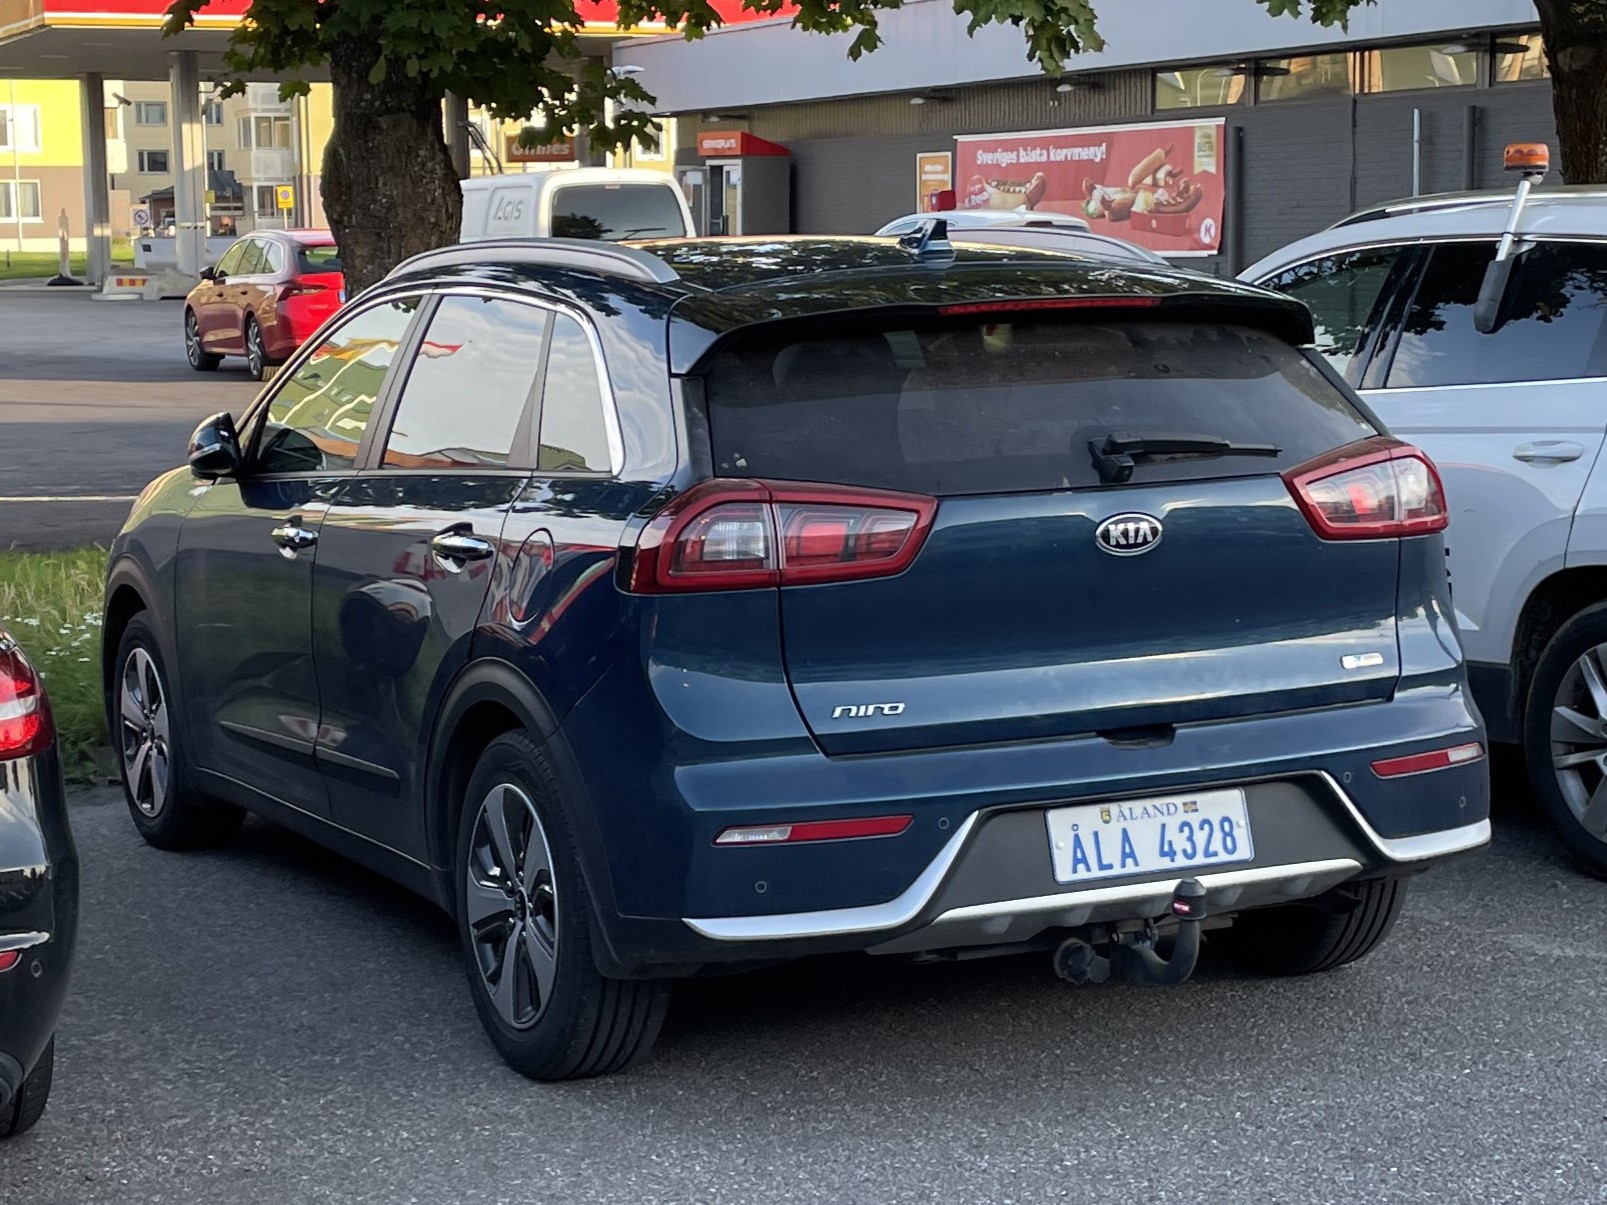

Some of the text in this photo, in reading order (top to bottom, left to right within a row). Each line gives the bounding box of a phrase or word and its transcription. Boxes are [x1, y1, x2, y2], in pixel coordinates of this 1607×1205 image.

[976, 149, 1018, 168] Sveriges
[1108, 521, 1153, 546] KIA
[1116, 801, 1179, 823] ÅLAND
[1071, 815, 1238, 875] ÅLA 4328
